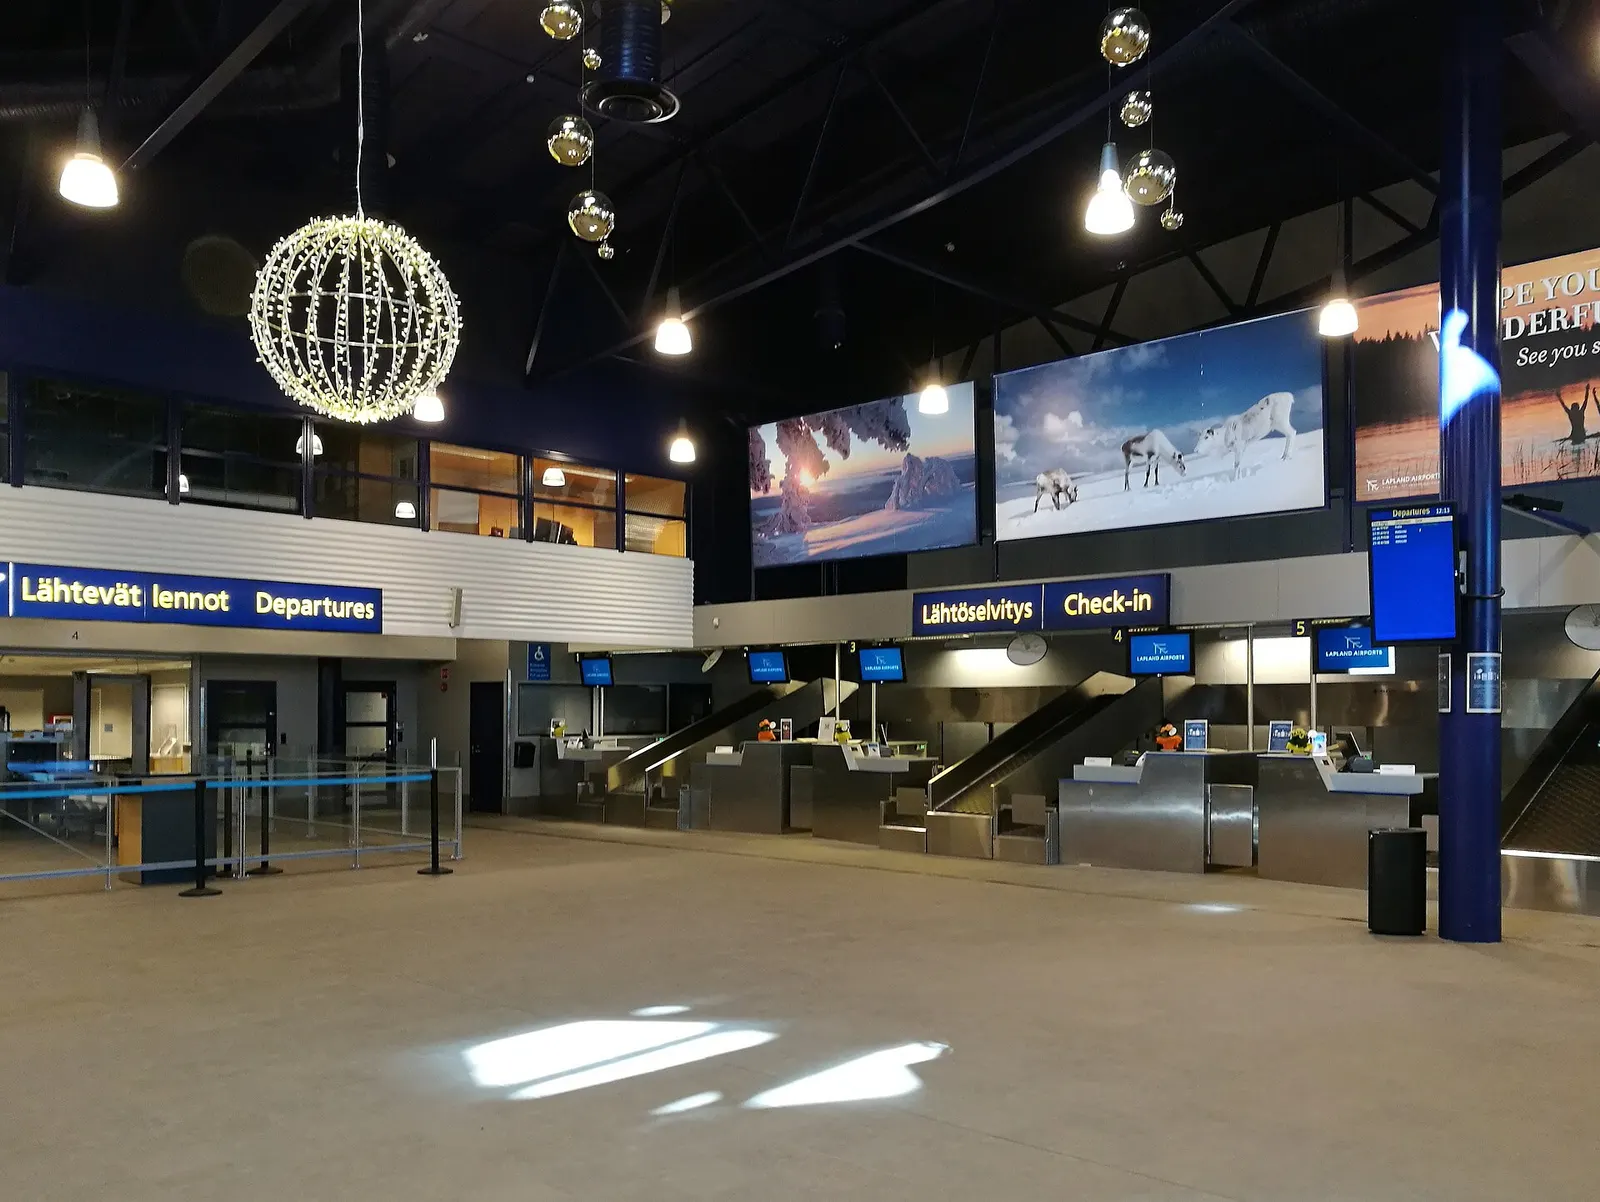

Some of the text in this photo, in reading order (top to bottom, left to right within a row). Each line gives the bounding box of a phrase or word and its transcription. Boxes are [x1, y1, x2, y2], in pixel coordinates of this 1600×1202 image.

[1501, 281, 1535, 310] PE
[1502, 301, 1600, 342] DERF
[1516, 347, 1548, 367] See
[1549, 342, 1588, 368] you
[1381, 476, 1410, 485] LAPLAND
[1392, 508, 1430, 518] Departures
[21, 576, 375, 620] Lähtevät lennot Departures
[922, 588, 1152, 625] Lähtöselvitys Check-in
[1114, 629, 1123, 643] 4
[1296, 621, 1305, 636] 5
[850, 641, 856, 653] 3
[1353, 649, 1383, 657] AIRPORTS
